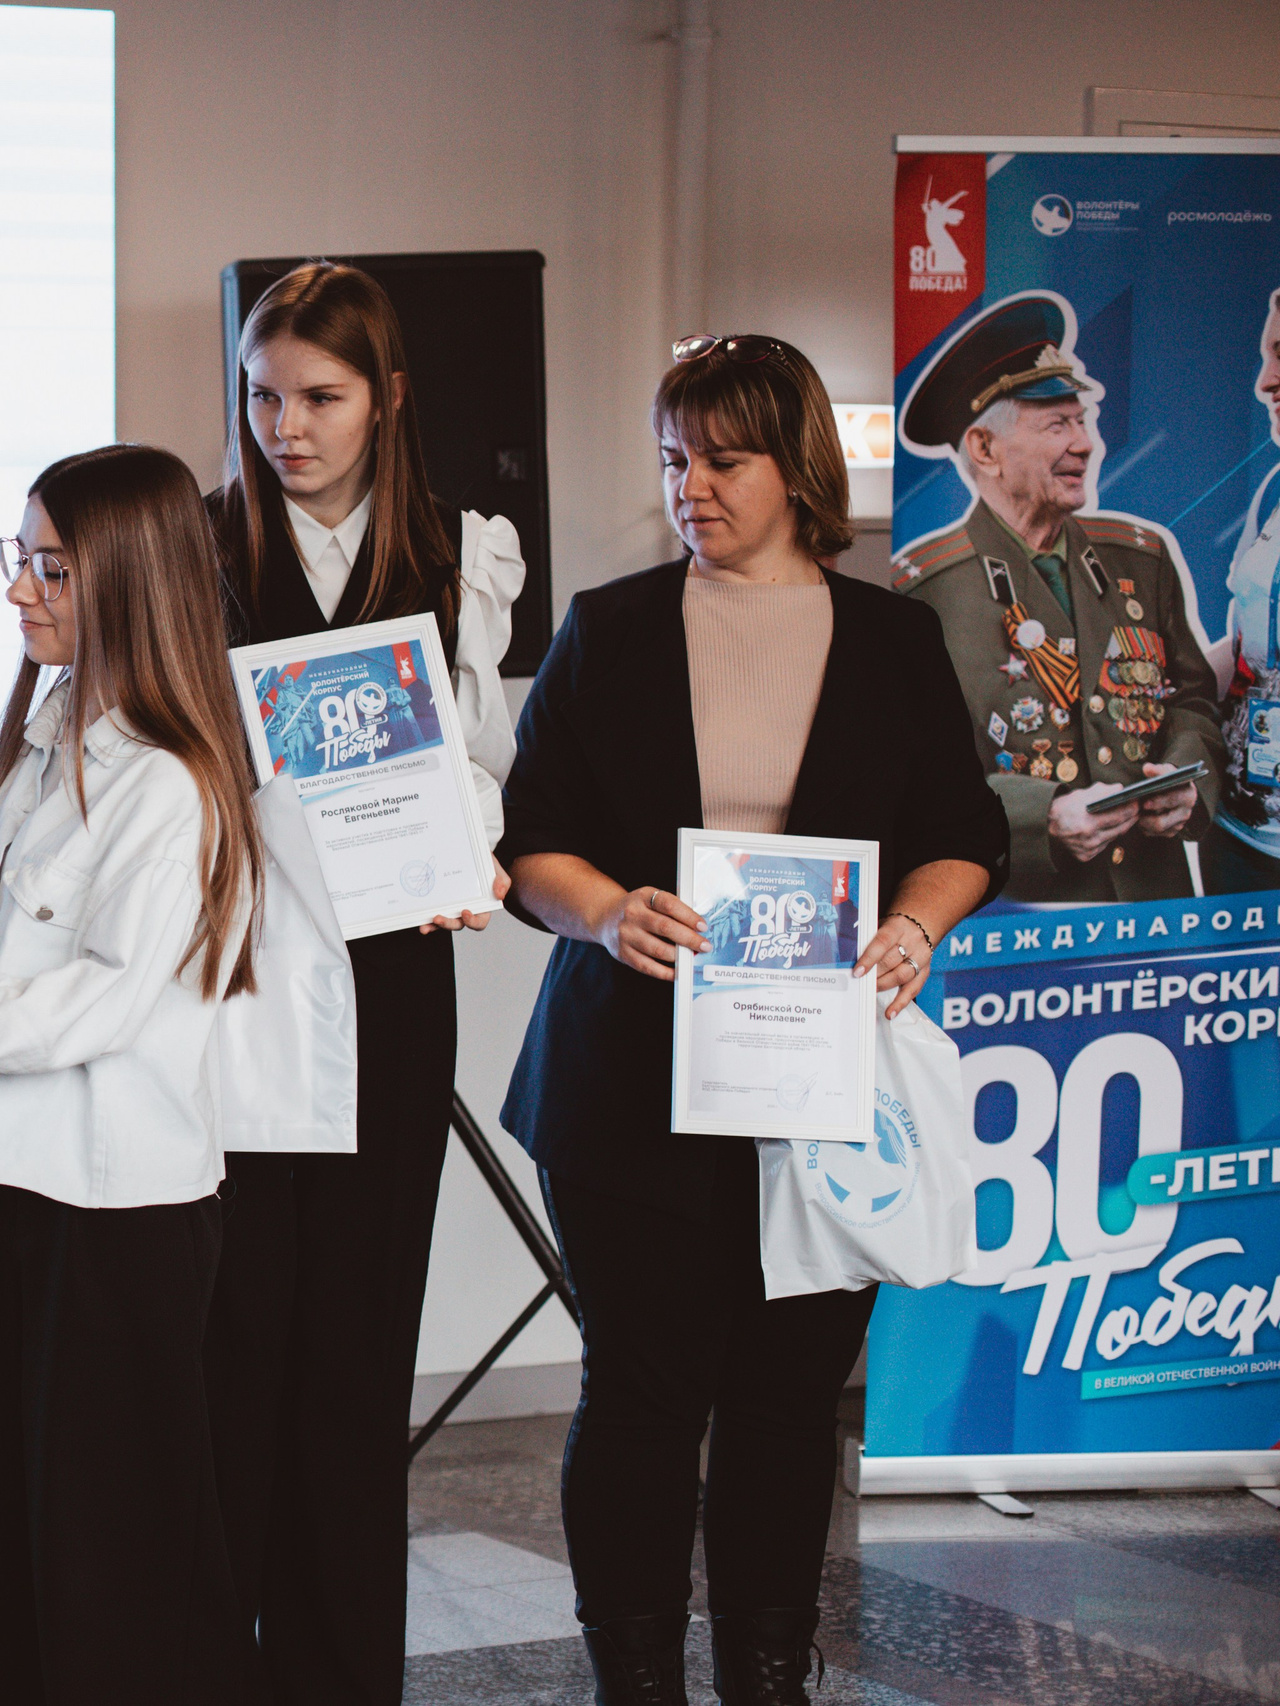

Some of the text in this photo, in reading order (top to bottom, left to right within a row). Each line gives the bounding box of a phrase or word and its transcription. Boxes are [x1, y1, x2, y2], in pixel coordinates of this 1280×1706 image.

[1076, 211, 1120, 221] ПОБЕДЫ
[1168, 210, 1272, 225] росмолодёжь
[909, 275, 968, 293] ПОБЕДА!
[311, 670, 370, 687] ВОЛОНТЁРСКИЙ
[313, 685, 342, 696] КОРПУС
[315, 729, 391, 769] Победы
[299, 759, 426, 790] БЛАГОДАРСТВЕННОЕ ПИСЬМО
[321, 799, 380, 818] Росляковой
[382, 792, 420, 806] Марине
[344, 806, 401, 824] Евгеньевне
[749, 876, 805, 886] ВОЛОНТЁРСКИЙ
[749, 884, 778, 892] КОРПУС
[738, 933, 811, 969] Победы
[714, 970, 836, 984] БЛАГОДАРСТВЕННОЕ ПИСЬМО
[943, 966, 1280, 1031] ВОЛОНТЁРСКИ
[733, 1002, 822, 1015] Орябинской Ольге
[749, 1013, 806, 1023] Николаевне
[1184, 1006, 1280, 1046] КОР
[807, 1140, 820, 1170] ВО
[950, 1032, 1184, 1286] 80
[1150, 1147, 1280, 1196] -ЛЕТ
[1094, 1378, 1102, 1390] В
[1104, 1371, 1155, 1389] ВЕЛИКОЙ
[1156, 1363, 1248, 1383] ОТЕЧЕСТВЕННОЙ
